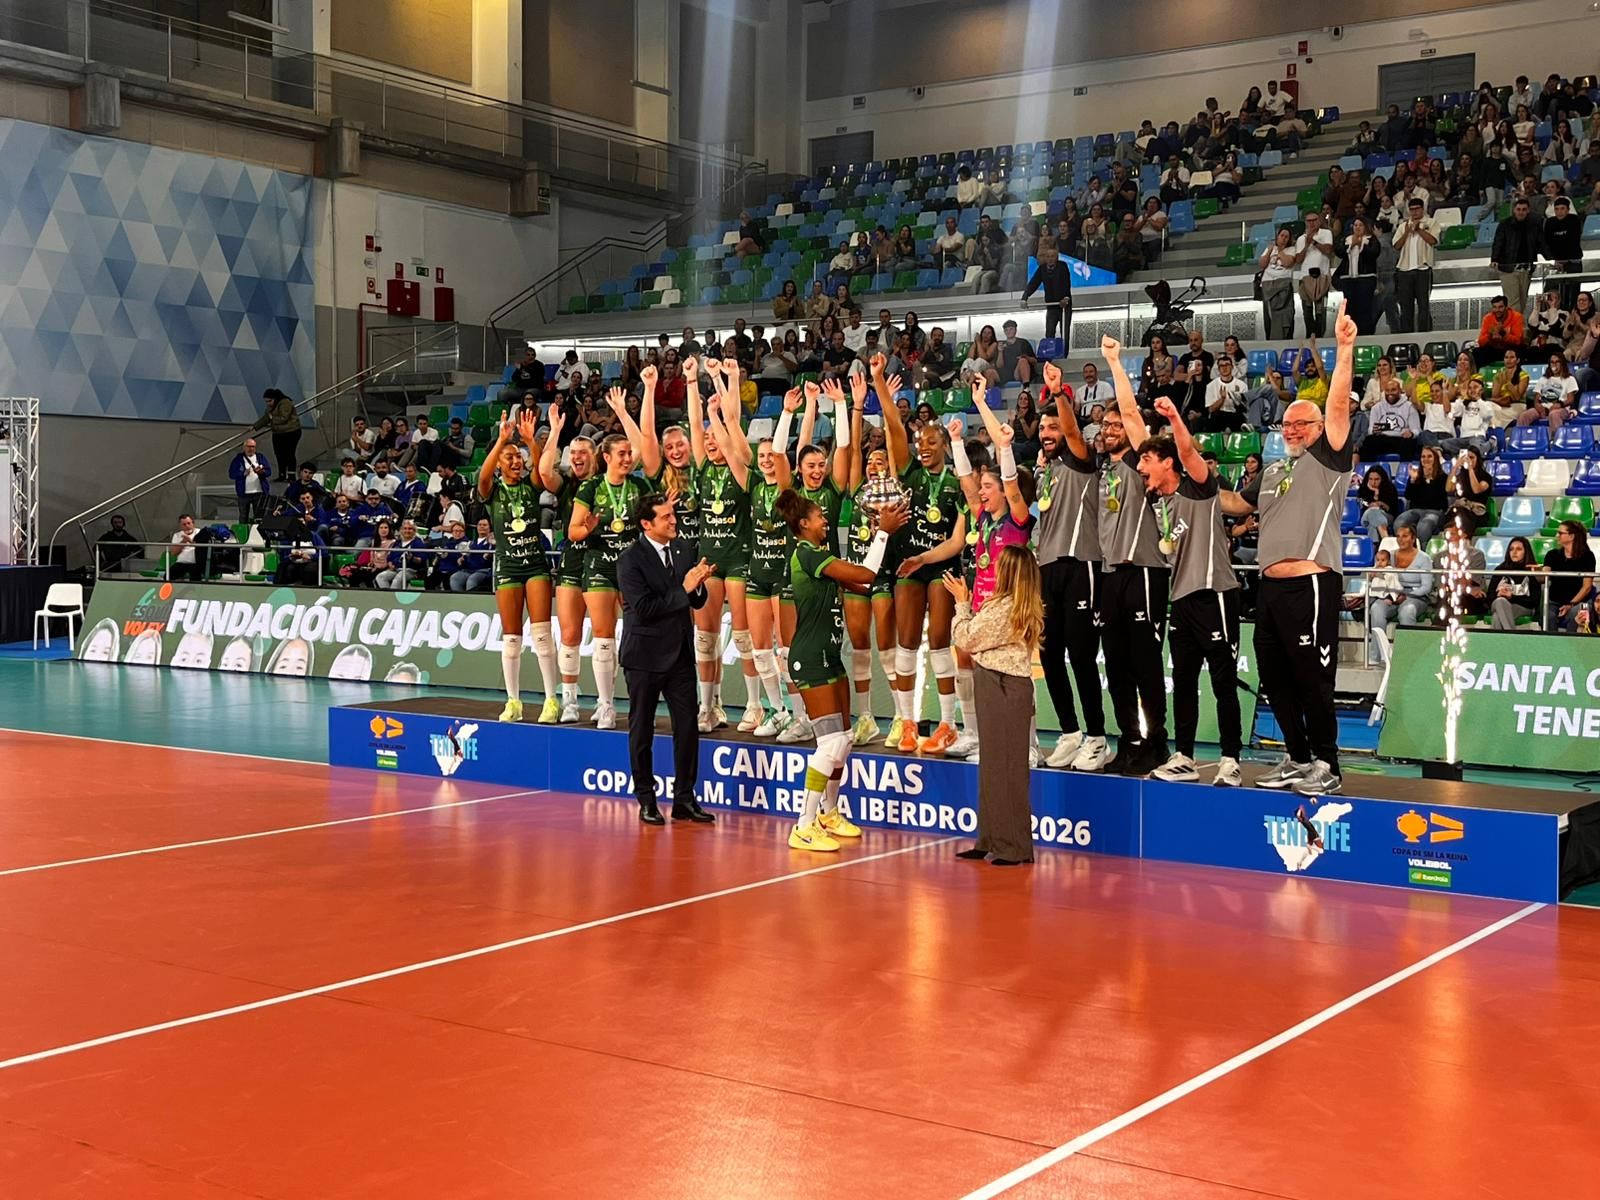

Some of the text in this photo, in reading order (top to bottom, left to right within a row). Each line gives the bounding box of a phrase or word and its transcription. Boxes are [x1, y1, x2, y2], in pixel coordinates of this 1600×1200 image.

[706, 514, 736, 527] Cajasol
[756, 535, 787, 549] Cajasol
[852, 541, 871, 555] Caja
[166, 595, 356, 643] FUNDACIÓN
[358, 607, 504, 657] CAJASOL
[1459, 661, 1576, 695] SANTA
[1513, 704, 1600, 738] TENE
[738, 784, 769, 810] LA
[775, 788, 853, 819] REA
[860, 796, 978, 833] IBERDRO
[1392, 847, 1411, 855] COPA
[1408, 858, 1452, 870] VOLEIBOL
